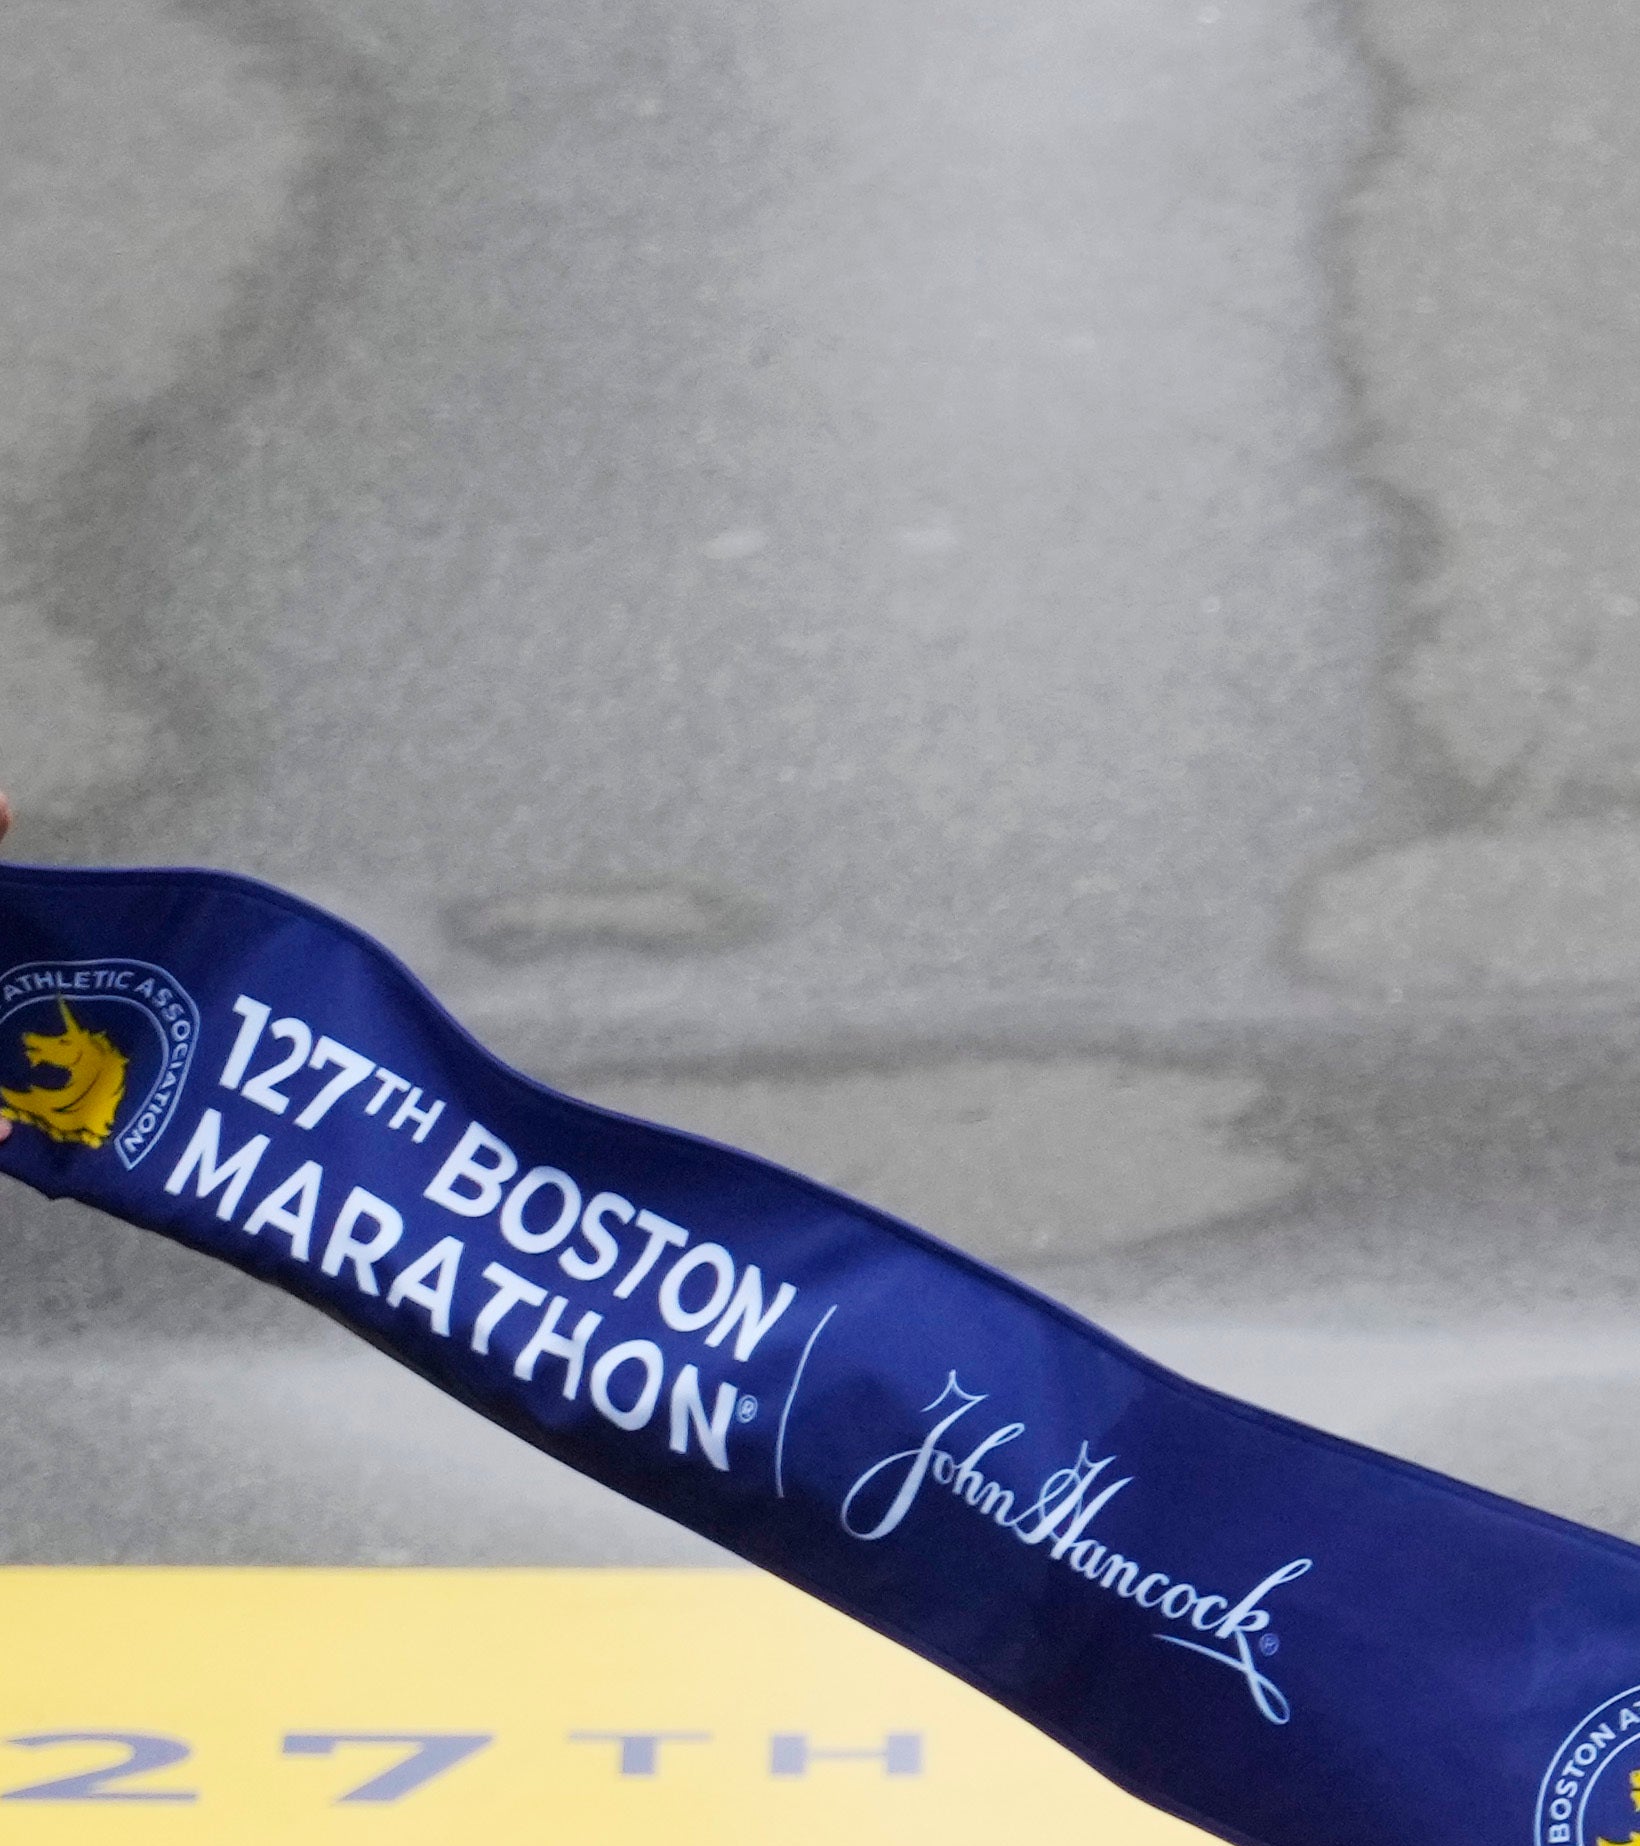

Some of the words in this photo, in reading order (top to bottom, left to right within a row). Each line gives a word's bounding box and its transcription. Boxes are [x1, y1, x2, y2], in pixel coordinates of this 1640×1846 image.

[3, 970, 135, 1001] ATHLETIC
[124, 977, 191, 1153] ASSOCIATION
[216, 994, 446, 1144] 127TH
[423, 1120, 798, 1362] BOSTON
[841, 1369, 1018, 1541] John
[0, 1726, 924, 1806] 27TH
[1547, 1723, 1617, 1844] BOSTON
